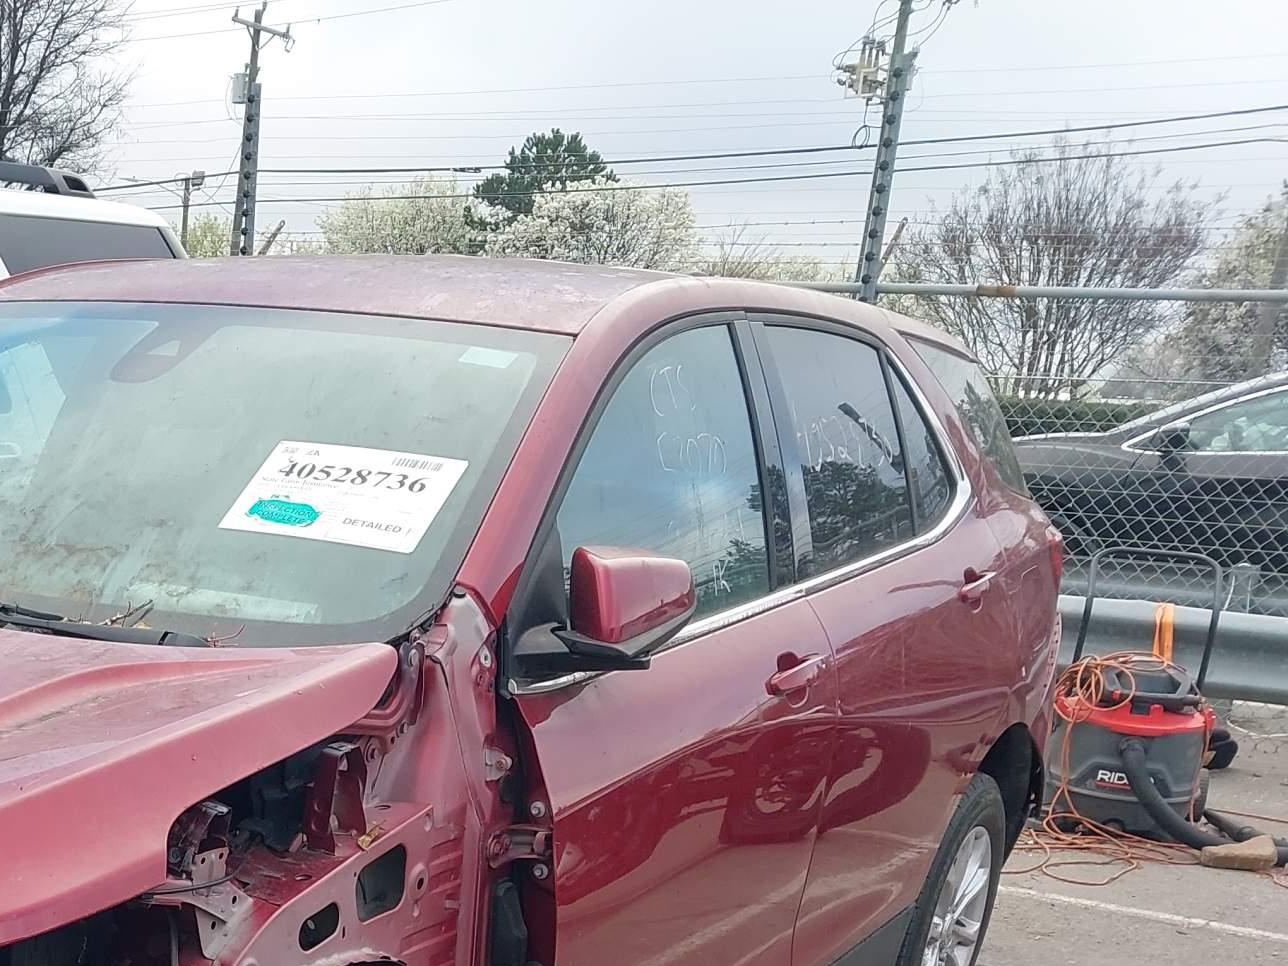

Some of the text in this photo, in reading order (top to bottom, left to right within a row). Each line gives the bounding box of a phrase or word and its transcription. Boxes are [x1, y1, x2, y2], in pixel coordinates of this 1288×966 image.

[278, 460, 432, 494] 40528736
[342, 517, 403, 534] DETAILED
[1096, 769, 1132, 785] RID
